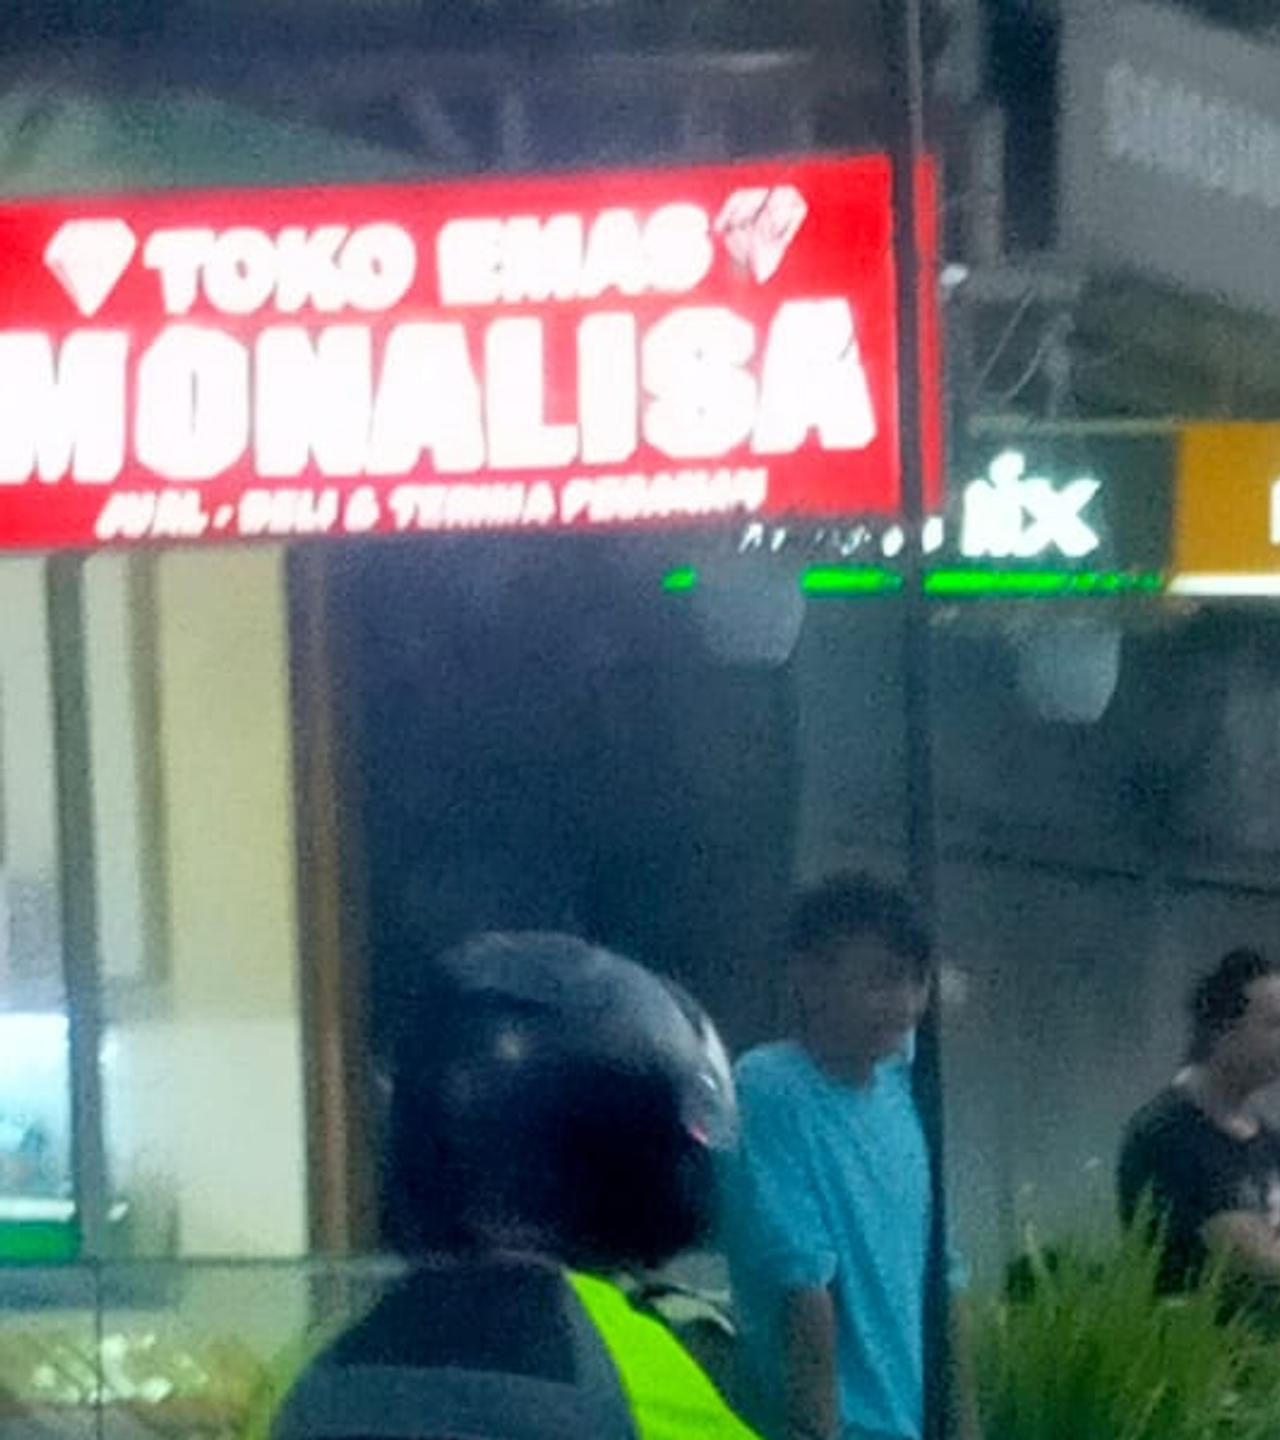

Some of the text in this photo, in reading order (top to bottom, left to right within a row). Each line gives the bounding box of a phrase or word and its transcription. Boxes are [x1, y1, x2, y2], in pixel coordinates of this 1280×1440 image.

[144, 203, 713, 316] TOKO EMAS
[0, 296, 877, 485] MONALISA
